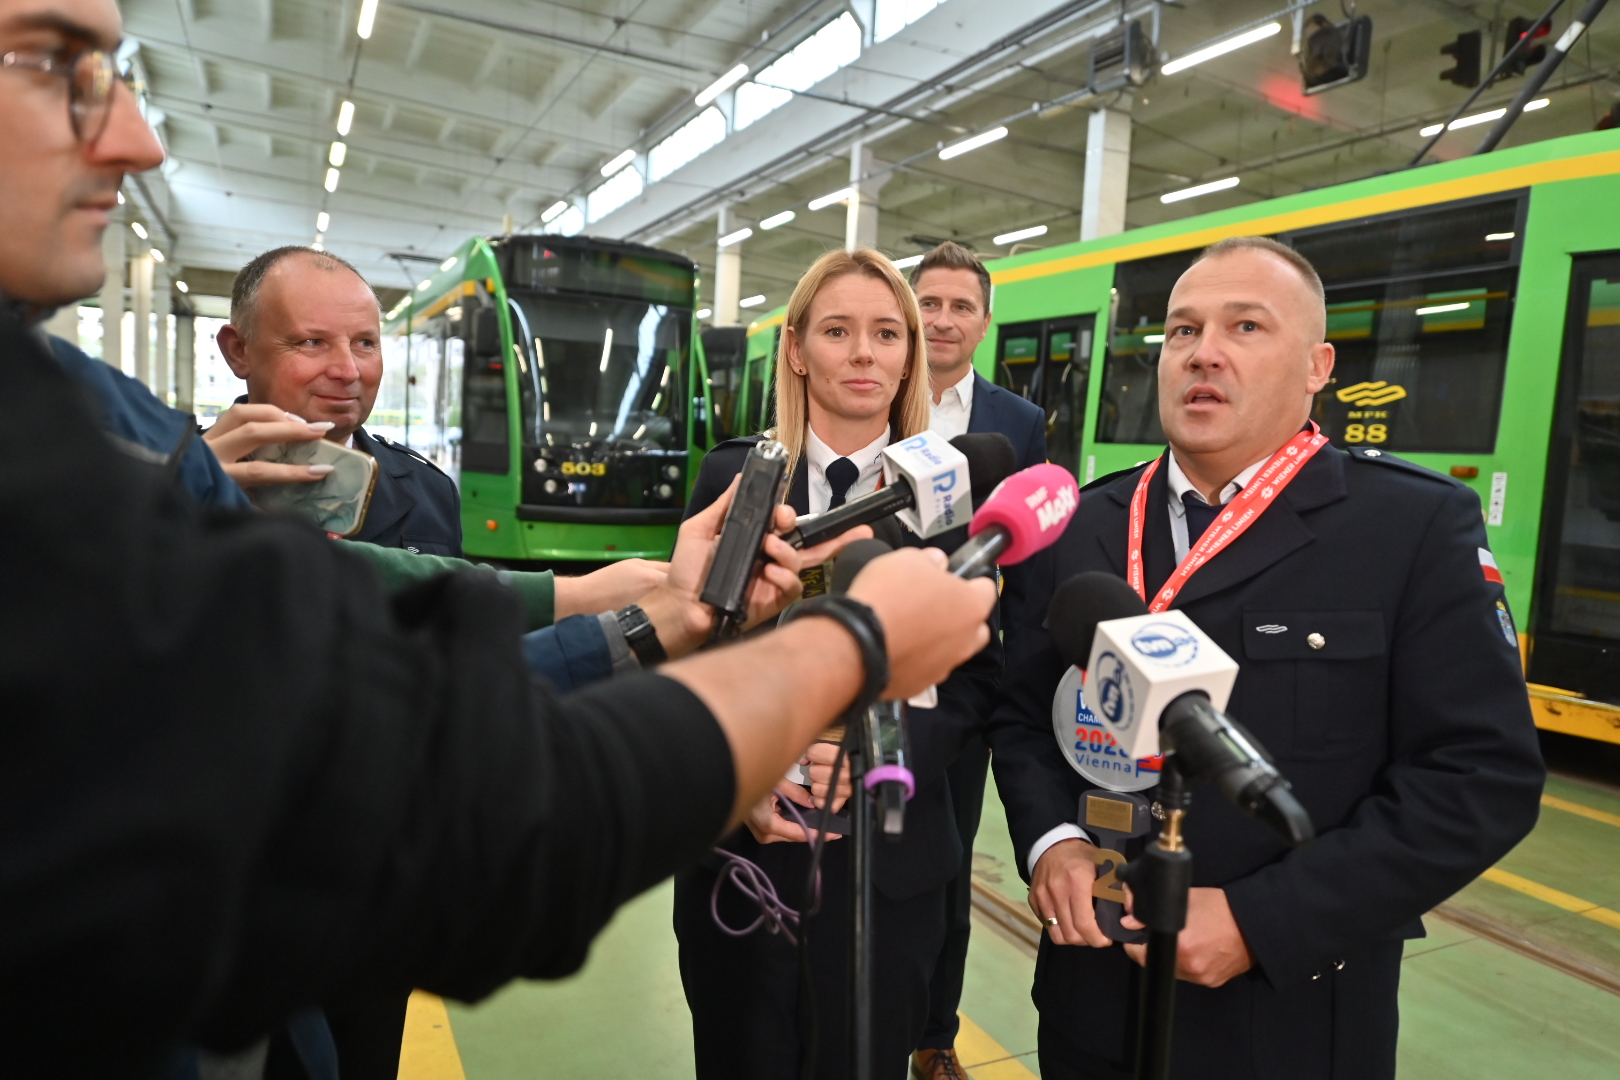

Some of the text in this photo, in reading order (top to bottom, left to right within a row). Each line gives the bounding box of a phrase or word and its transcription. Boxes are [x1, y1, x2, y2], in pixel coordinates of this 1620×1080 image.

[1347, 411, 1388, 419] MPK
[1344, 423, 1387, 443] 88
[921, 448, 942, 465] Radio
[561, 461, 606, 476] 503
[1242, 455, 1288, 499] WIENER LINIEN
[1271, 462, 1295, 485] WIENER
[1024, 486, 1048, 510] RMF
[943, 495, 954, 525] Radio
[1206, 508, 1255, 553] WIENER LINIEN
[1181, 525, 1223, 577] WIENER LINIEN
[1075, 753, 1132, 773] Vienna
[1092, 848, 1128, 904] 2
